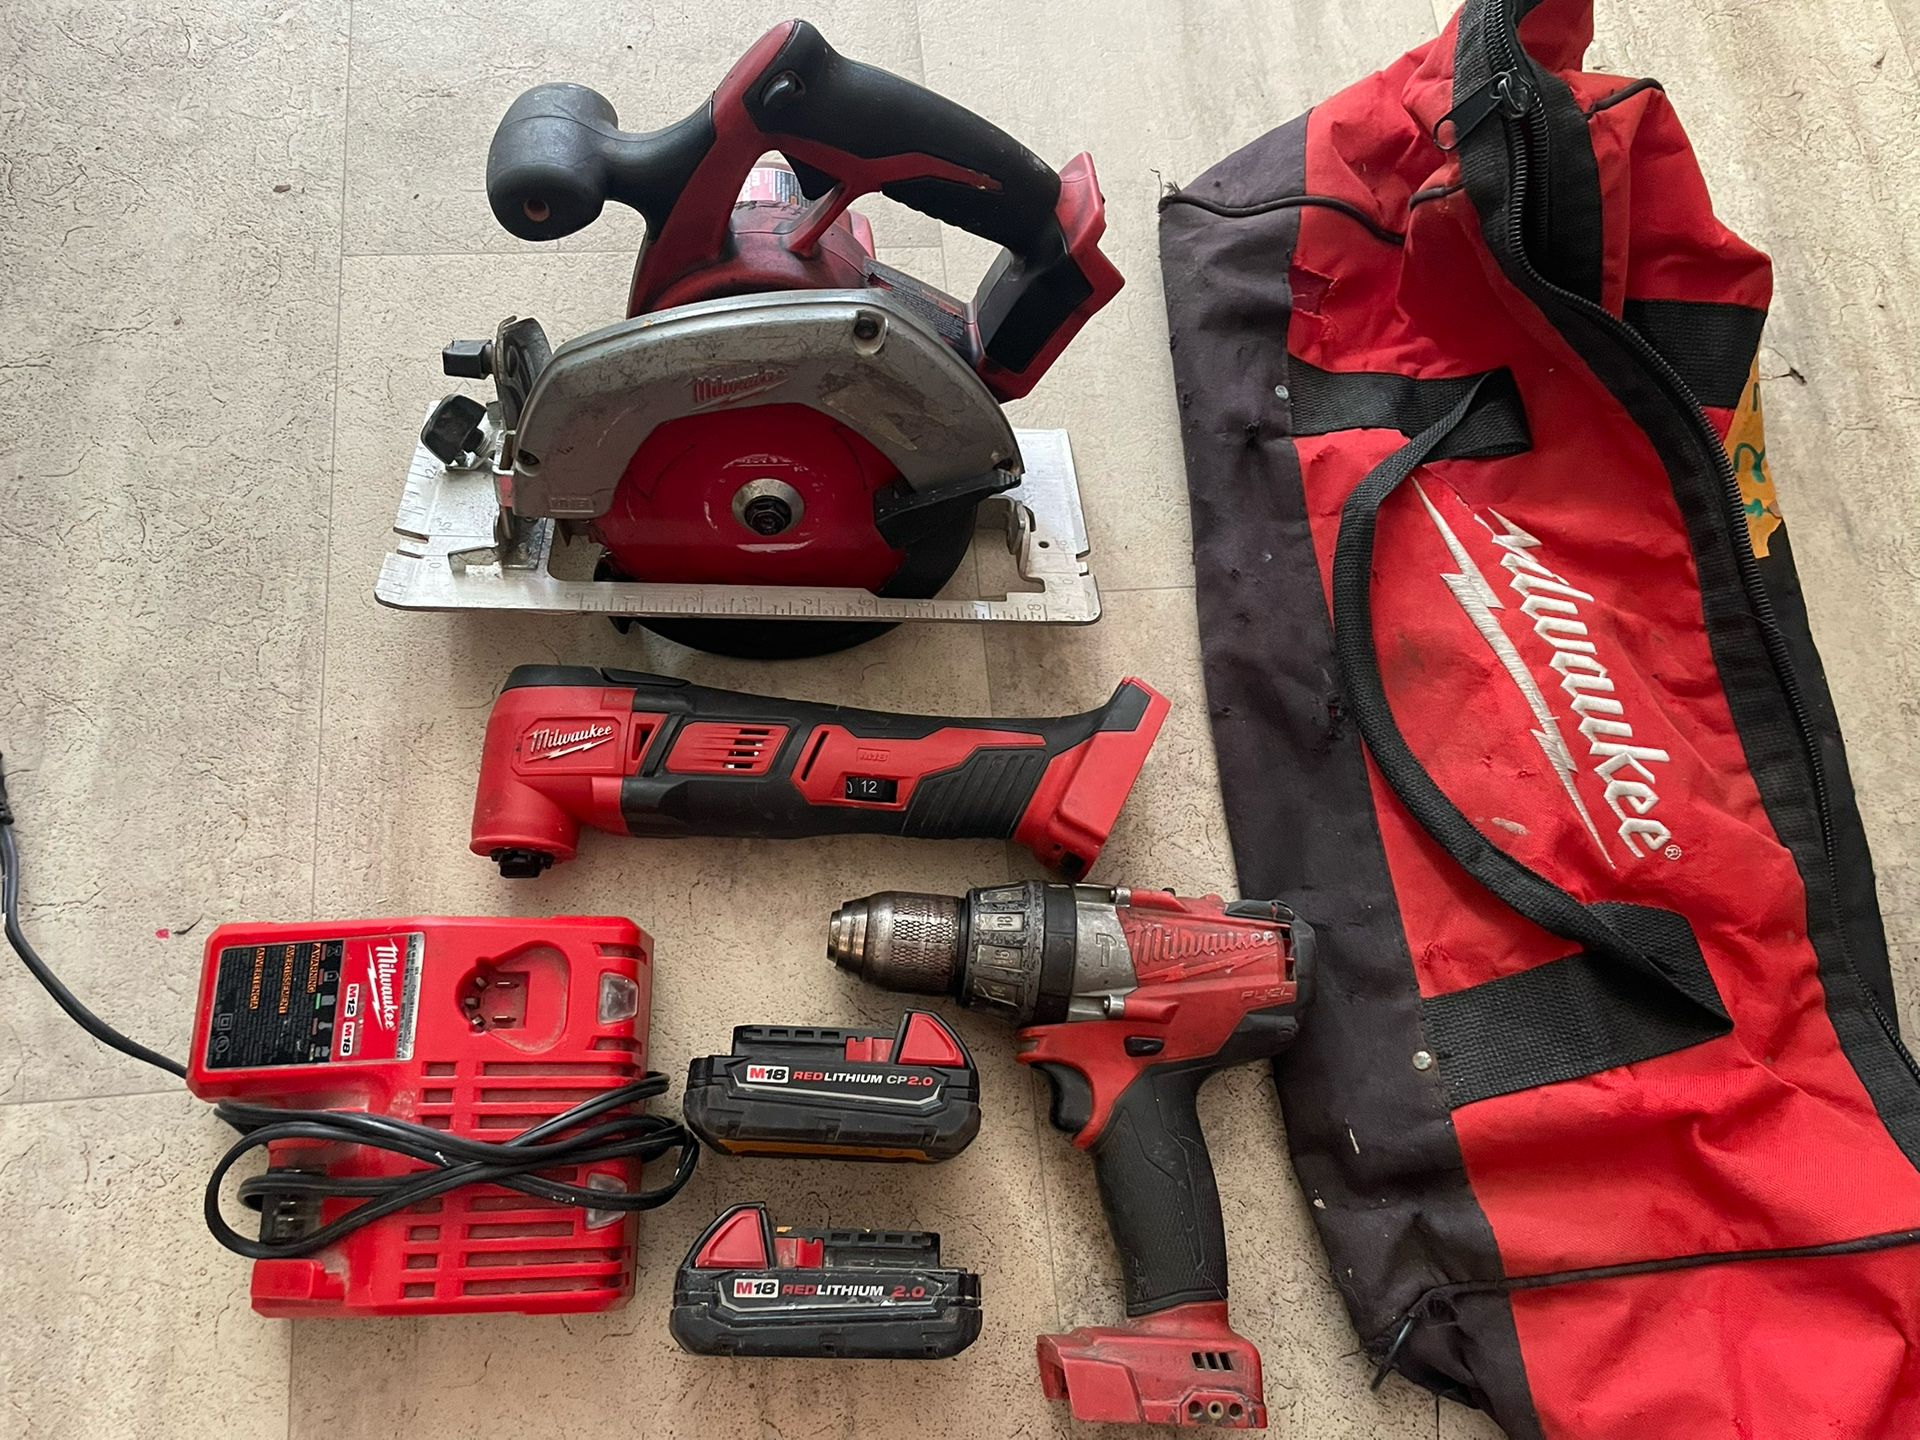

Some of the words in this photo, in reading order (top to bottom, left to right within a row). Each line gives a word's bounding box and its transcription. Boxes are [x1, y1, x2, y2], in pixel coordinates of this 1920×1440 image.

[529, 723, 614, 752] Milwaukee
[861, 780, 877, 793] 12
[1126, 921, 1279, 965] Milwaukee
[307, 951, 320, 993] WARNING
[374, 938, 399, 1031] Milwaukee
[346, 986, 358, 1015] M12
[1240, 987, 1293, 1001] FUEL
[342, 1024, 354, 1054] M18
[749, 1067, 787, 1081] M18
[735, 1281, 777, 1295] M18
[890, 1285, 926, 1298] 2.0
